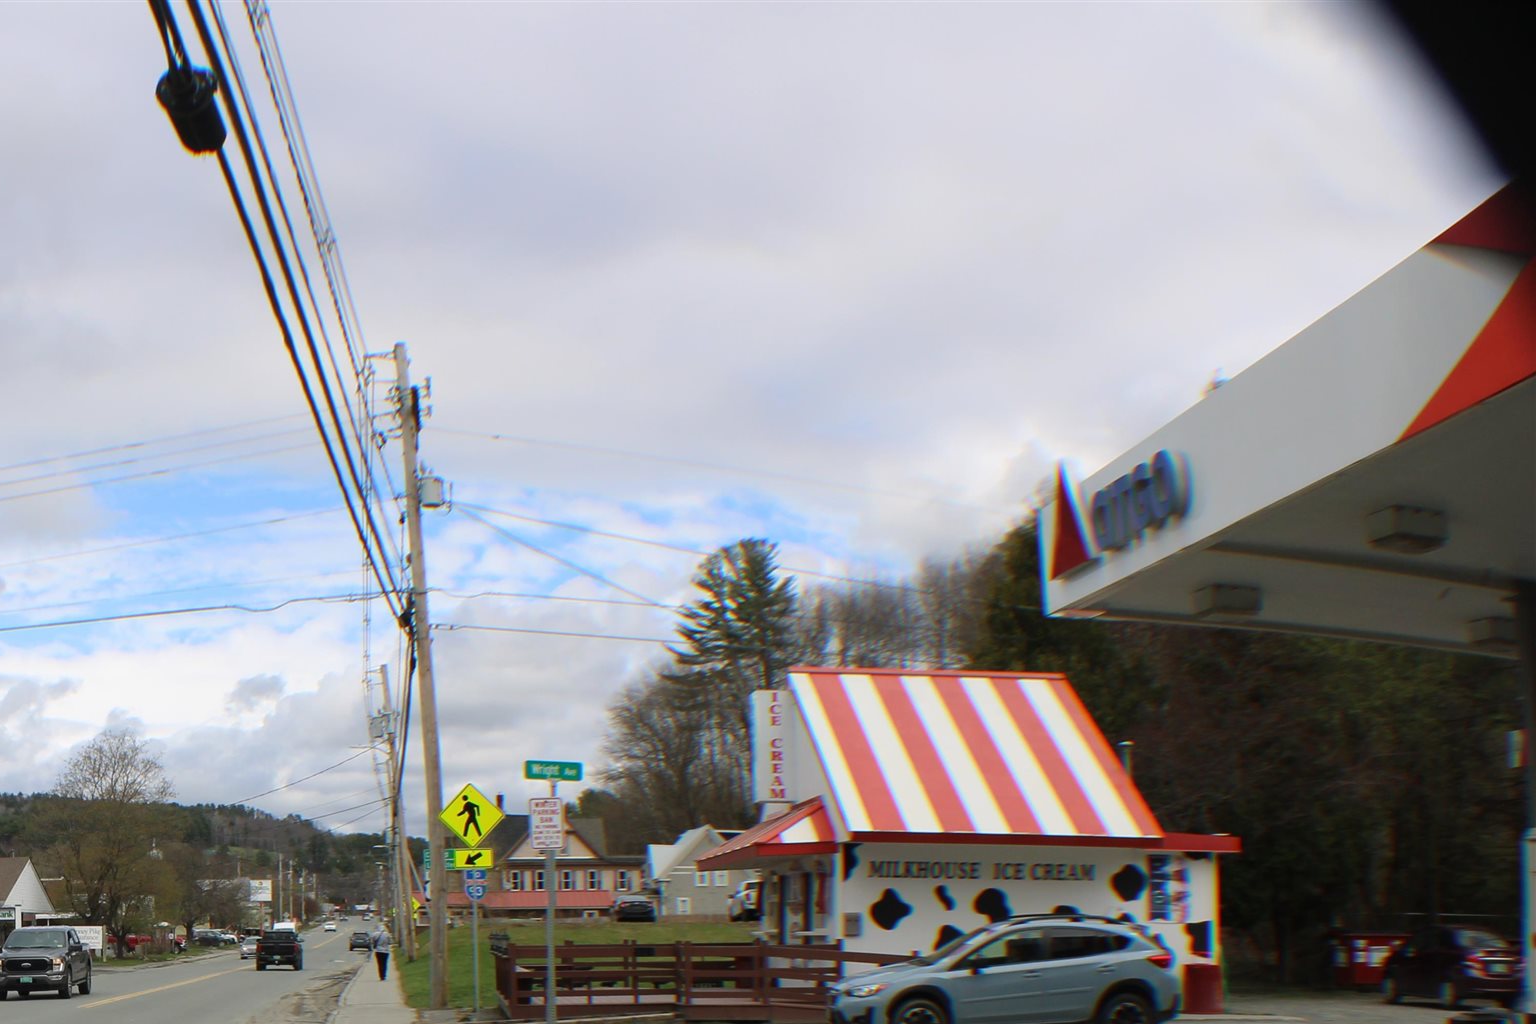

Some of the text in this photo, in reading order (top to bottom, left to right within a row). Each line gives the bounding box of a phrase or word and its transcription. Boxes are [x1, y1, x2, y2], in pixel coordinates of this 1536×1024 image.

[770, 692, 785, 798] ICE CREAM
[532, 764, 560, 777] Wright
[533, 808, 560, 816] PARKING
[867, 861, 1096, 881] MILKHOUSE ICE CREAM
[469, 886, 483, 896] 93
